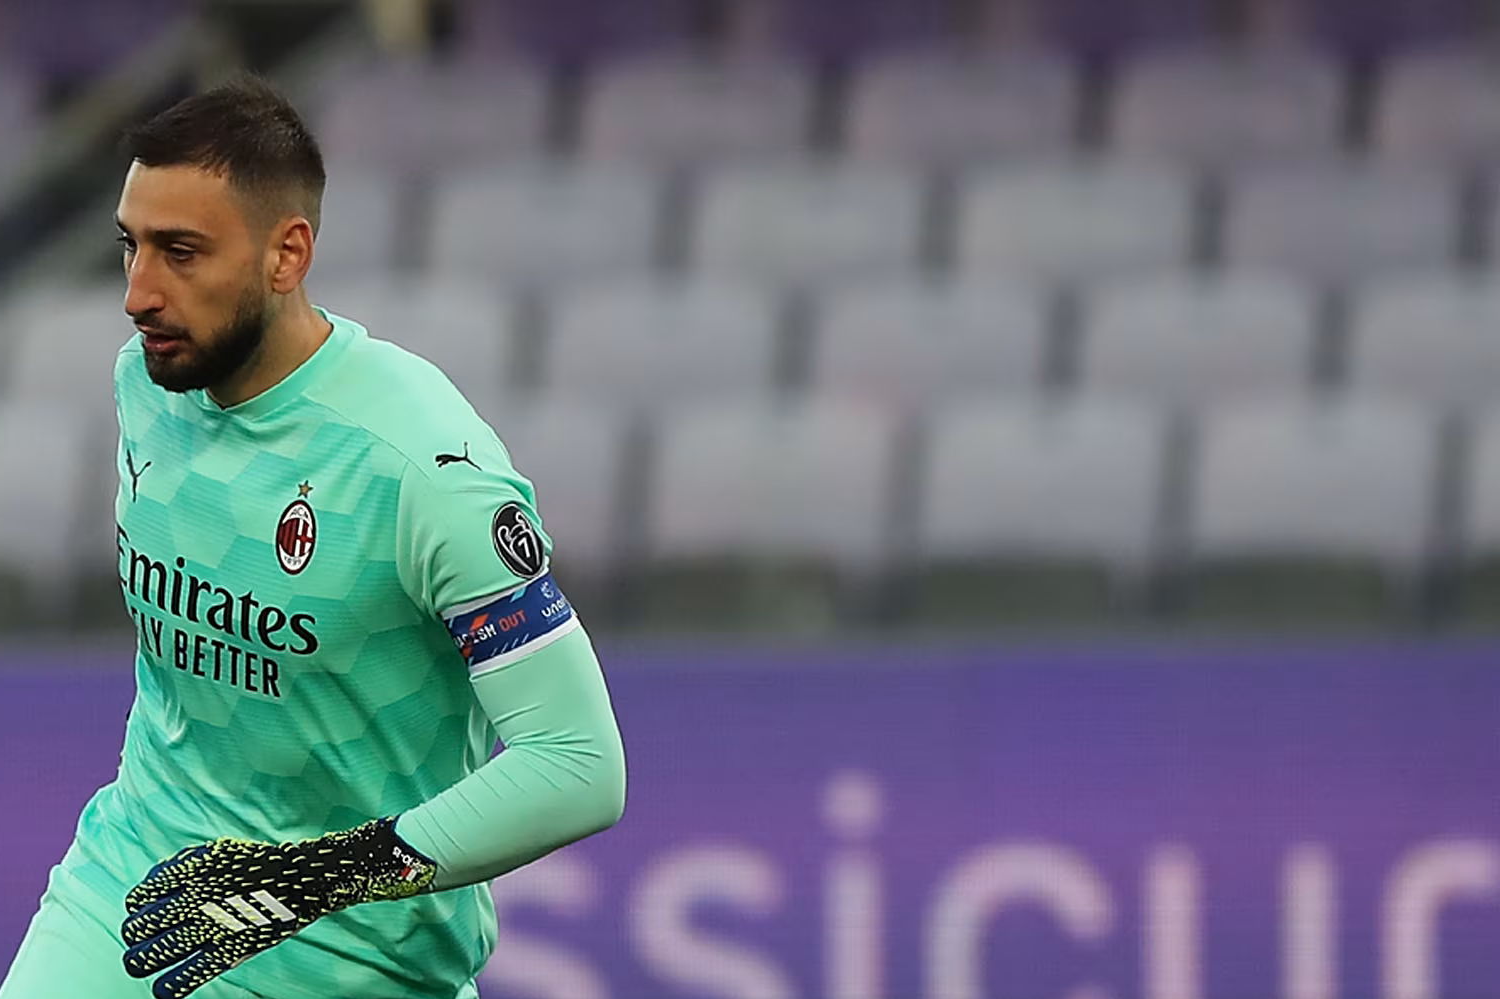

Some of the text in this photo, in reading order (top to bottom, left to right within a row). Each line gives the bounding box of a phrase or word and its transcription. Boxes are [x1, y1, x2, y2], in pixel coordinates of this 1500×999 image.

[499, 610, 528, 632] OUT
[131, 604, 281, 698] LY BETTER
